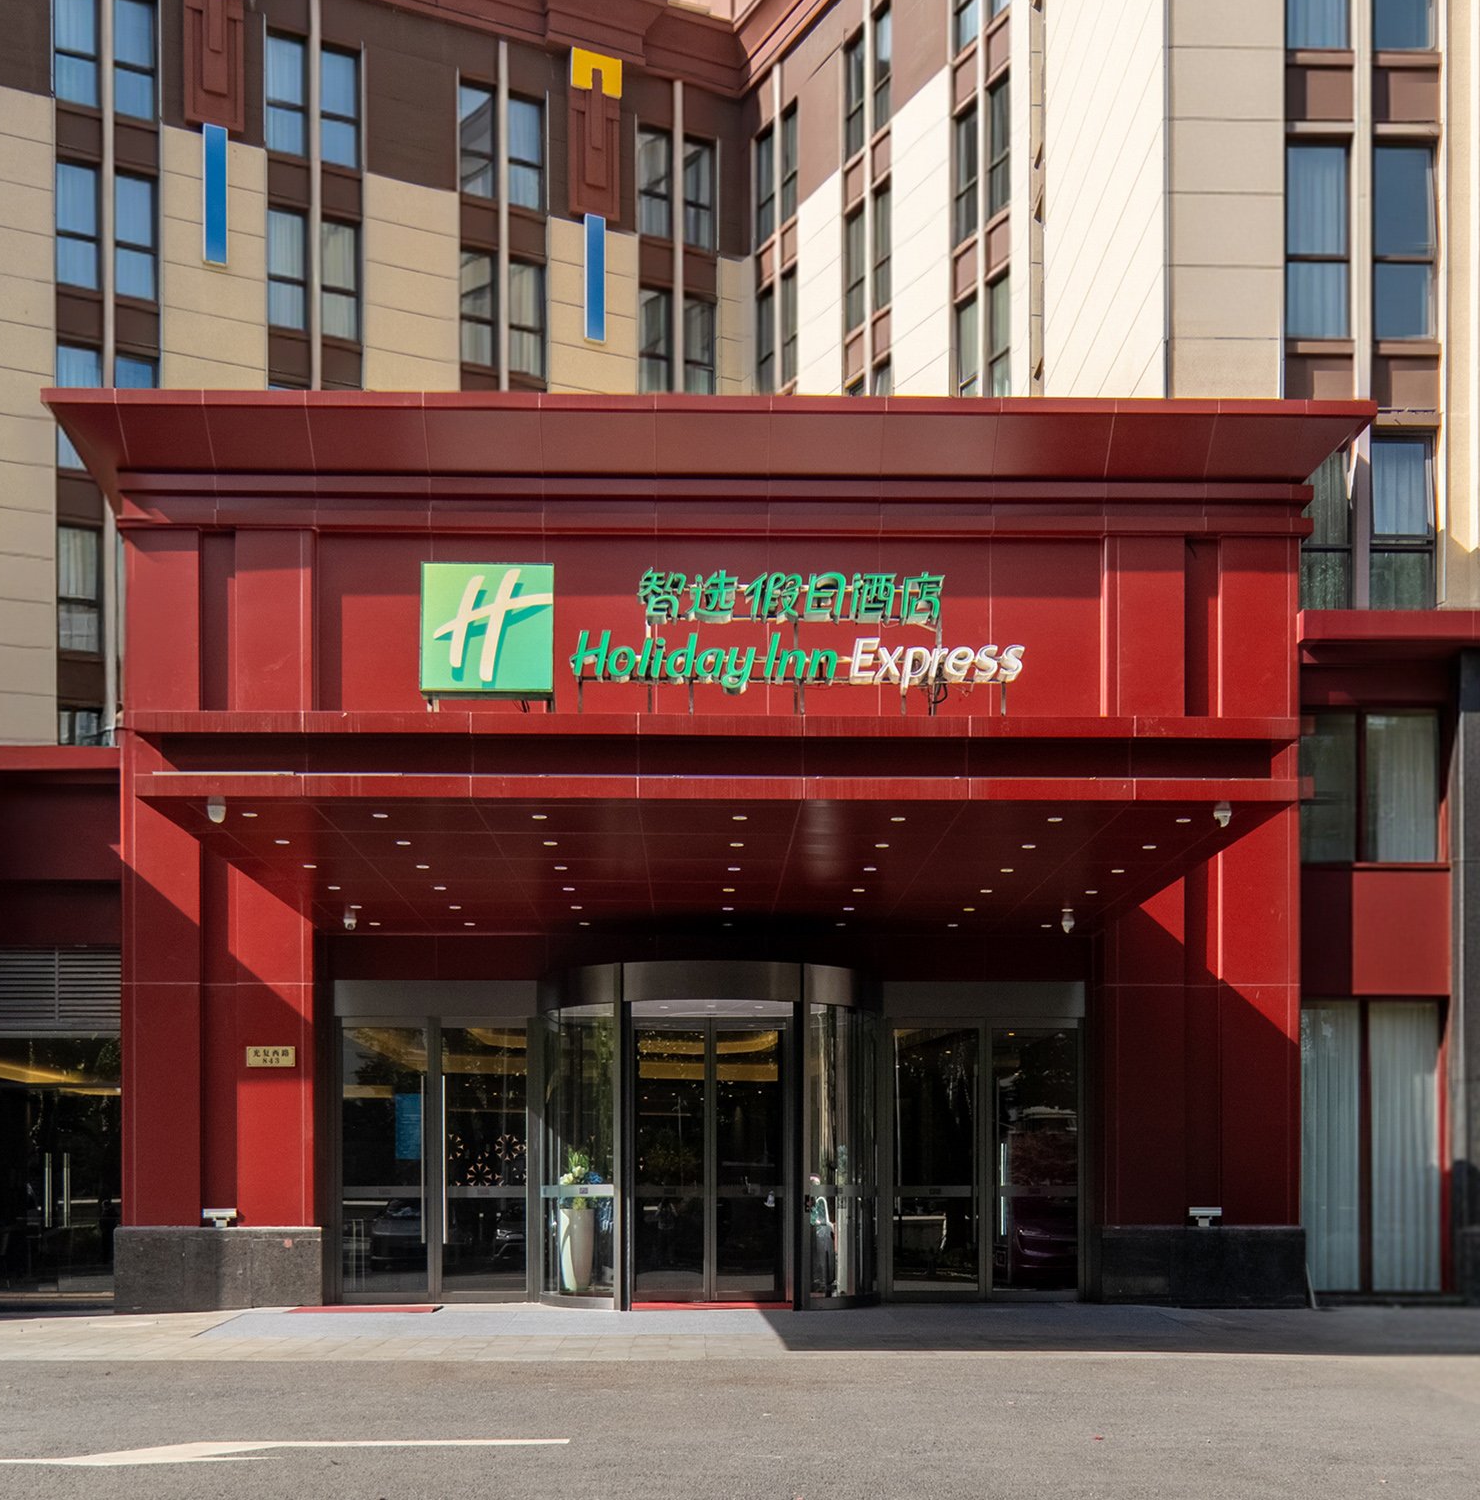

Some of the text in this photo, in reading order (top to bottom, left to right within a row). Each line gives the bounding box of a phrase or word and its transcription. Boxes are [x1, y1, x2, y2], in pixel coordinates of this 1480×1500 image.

[637, 567, 945, 625] 智选假日酒店
[569, 630, 1025, 696] Holiday Inn Express
